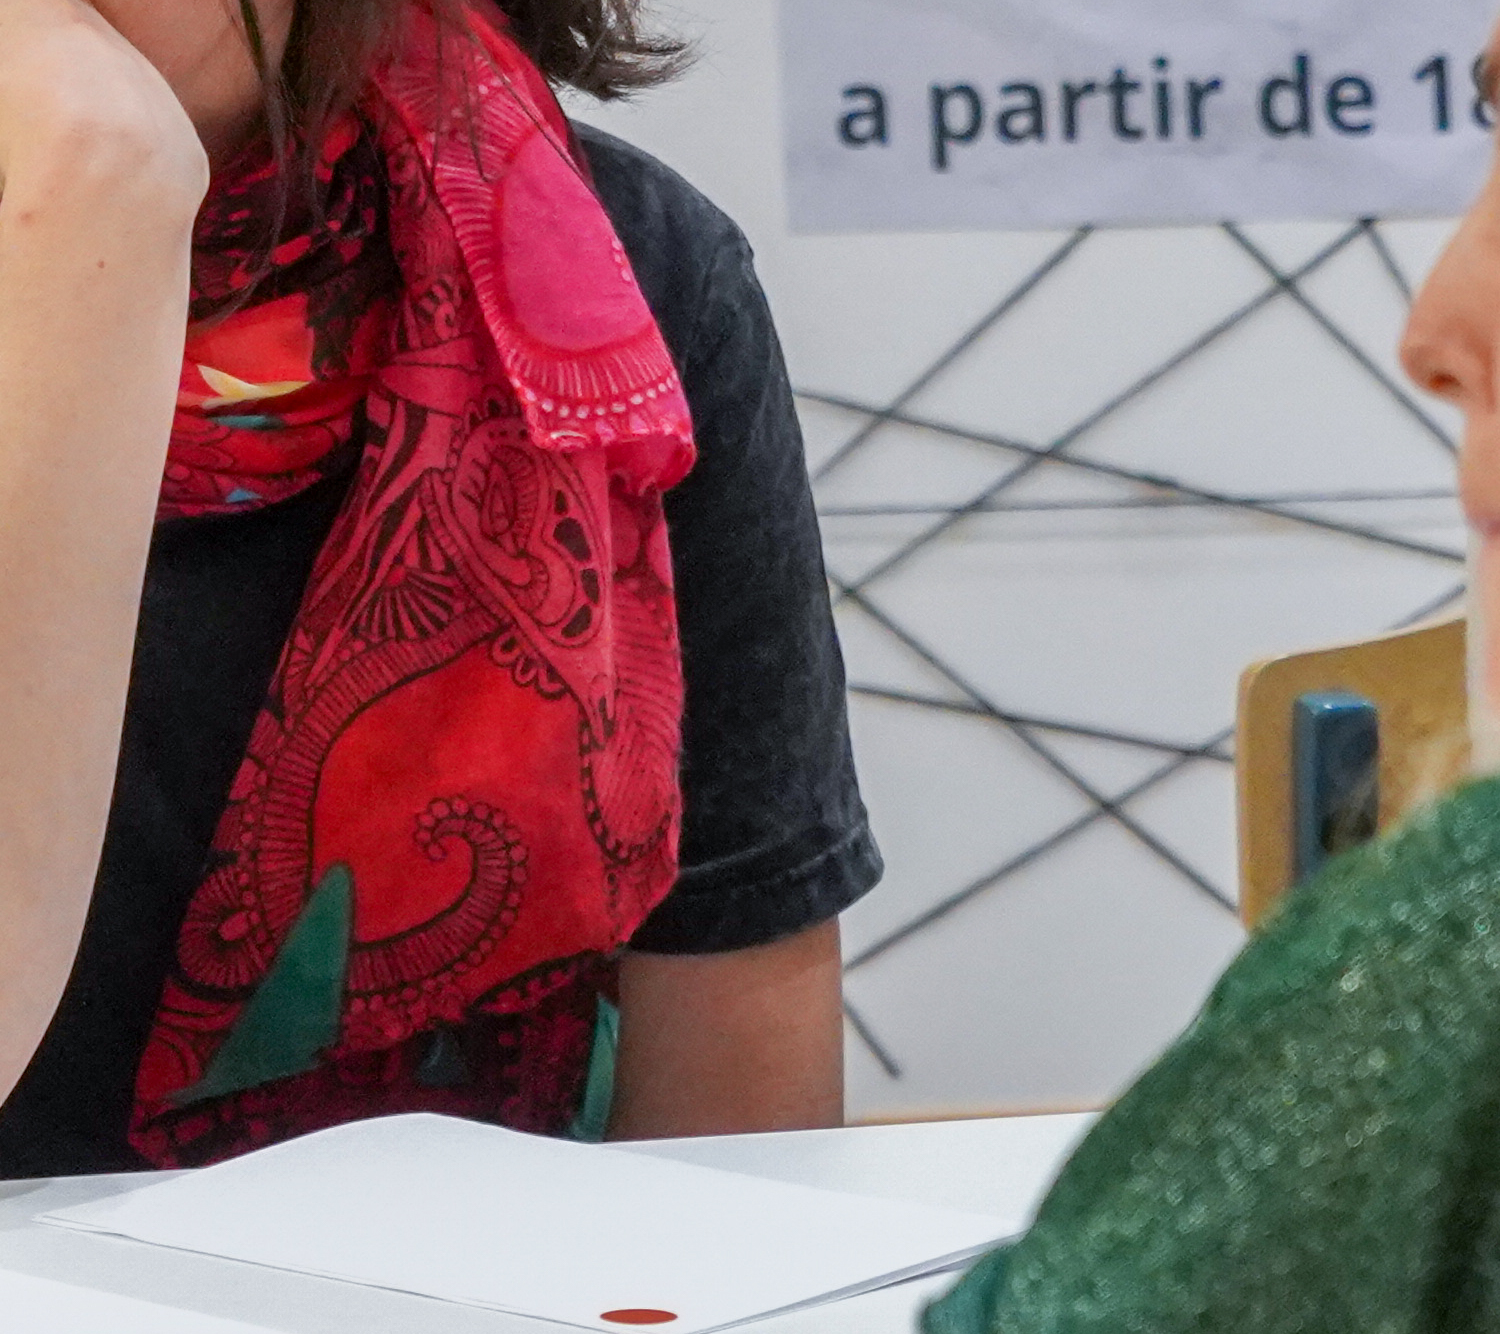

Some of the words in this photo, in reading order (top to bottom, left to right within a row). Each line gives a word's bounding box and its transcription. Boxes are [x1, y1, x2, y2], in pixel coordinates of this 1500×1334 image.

[836, 83, 891, 149] a
[928, 56, 1224, 173] partir
[1257, 51, 1377, 139] de
